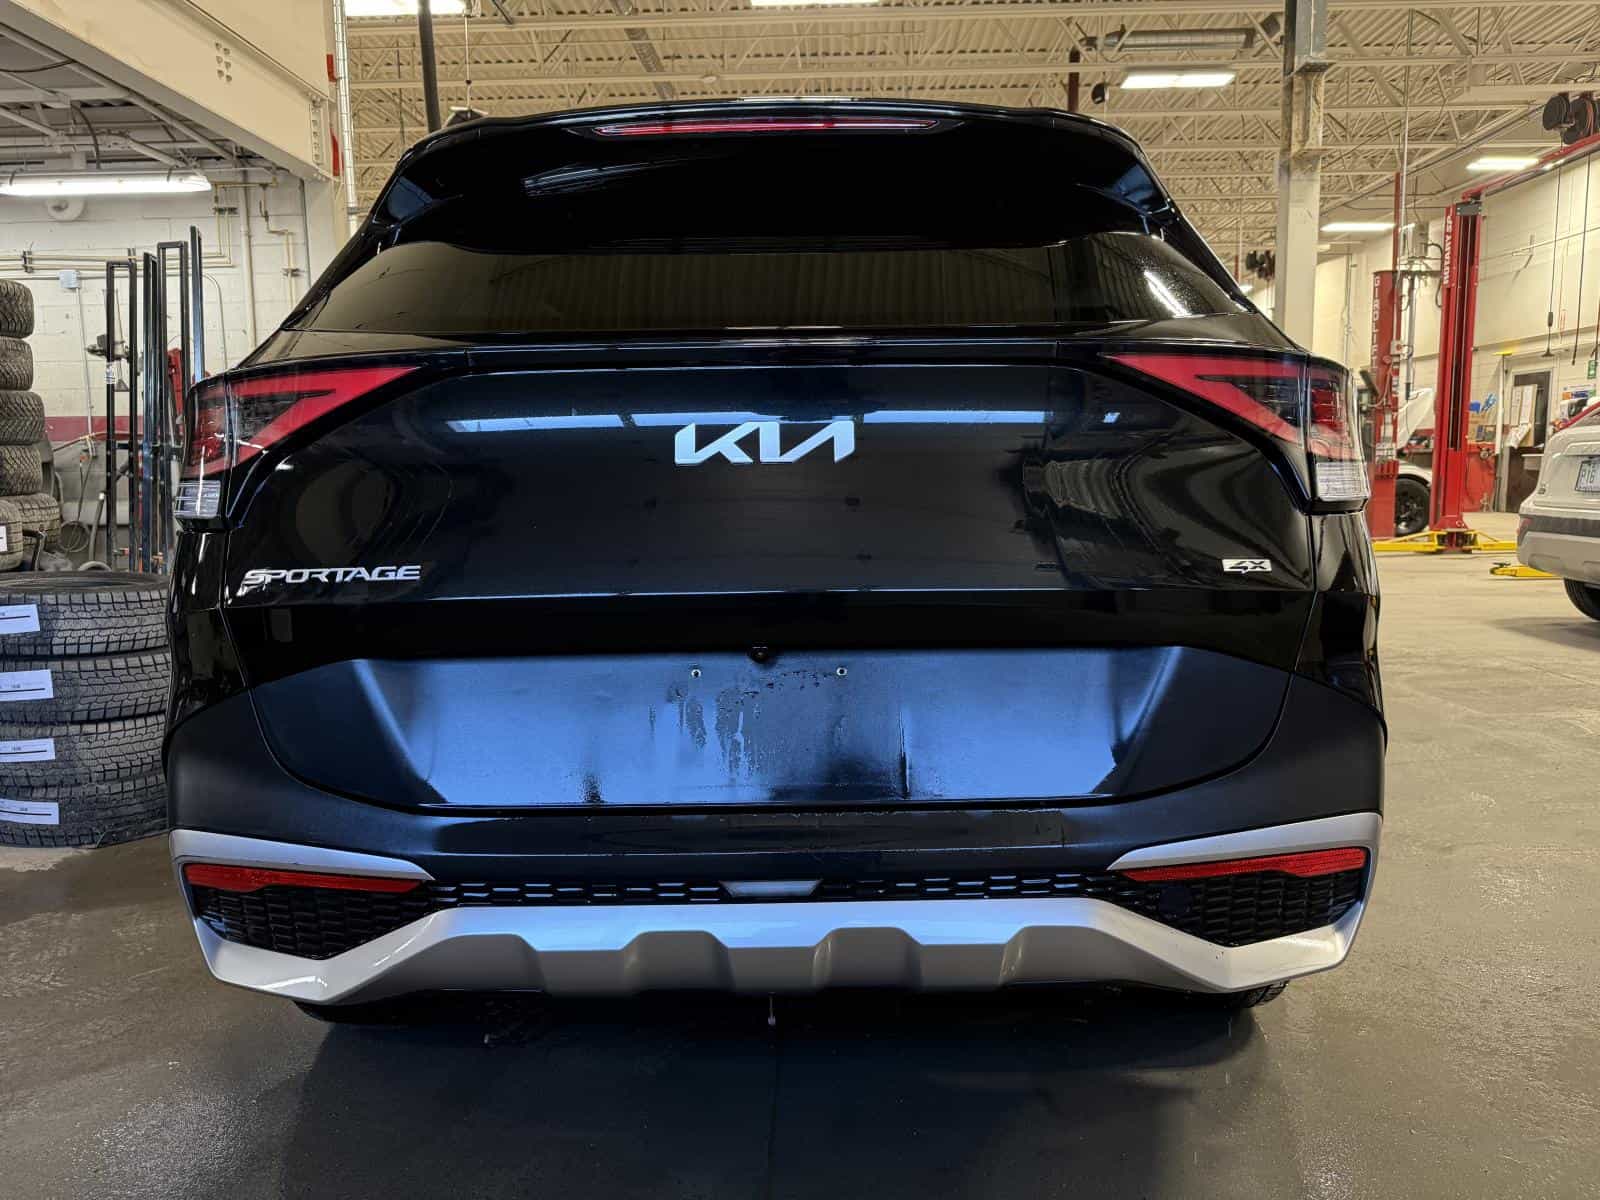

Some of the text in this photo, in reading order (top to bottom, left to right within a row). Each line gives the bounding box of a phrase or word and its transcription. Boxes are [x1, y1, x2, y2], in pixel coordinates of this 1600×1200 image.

[1443, 234, 1453, 285] ROTARY
[674, 420, 856, 466] KIA
[240, 565, 421, 587] SPORTAGE
